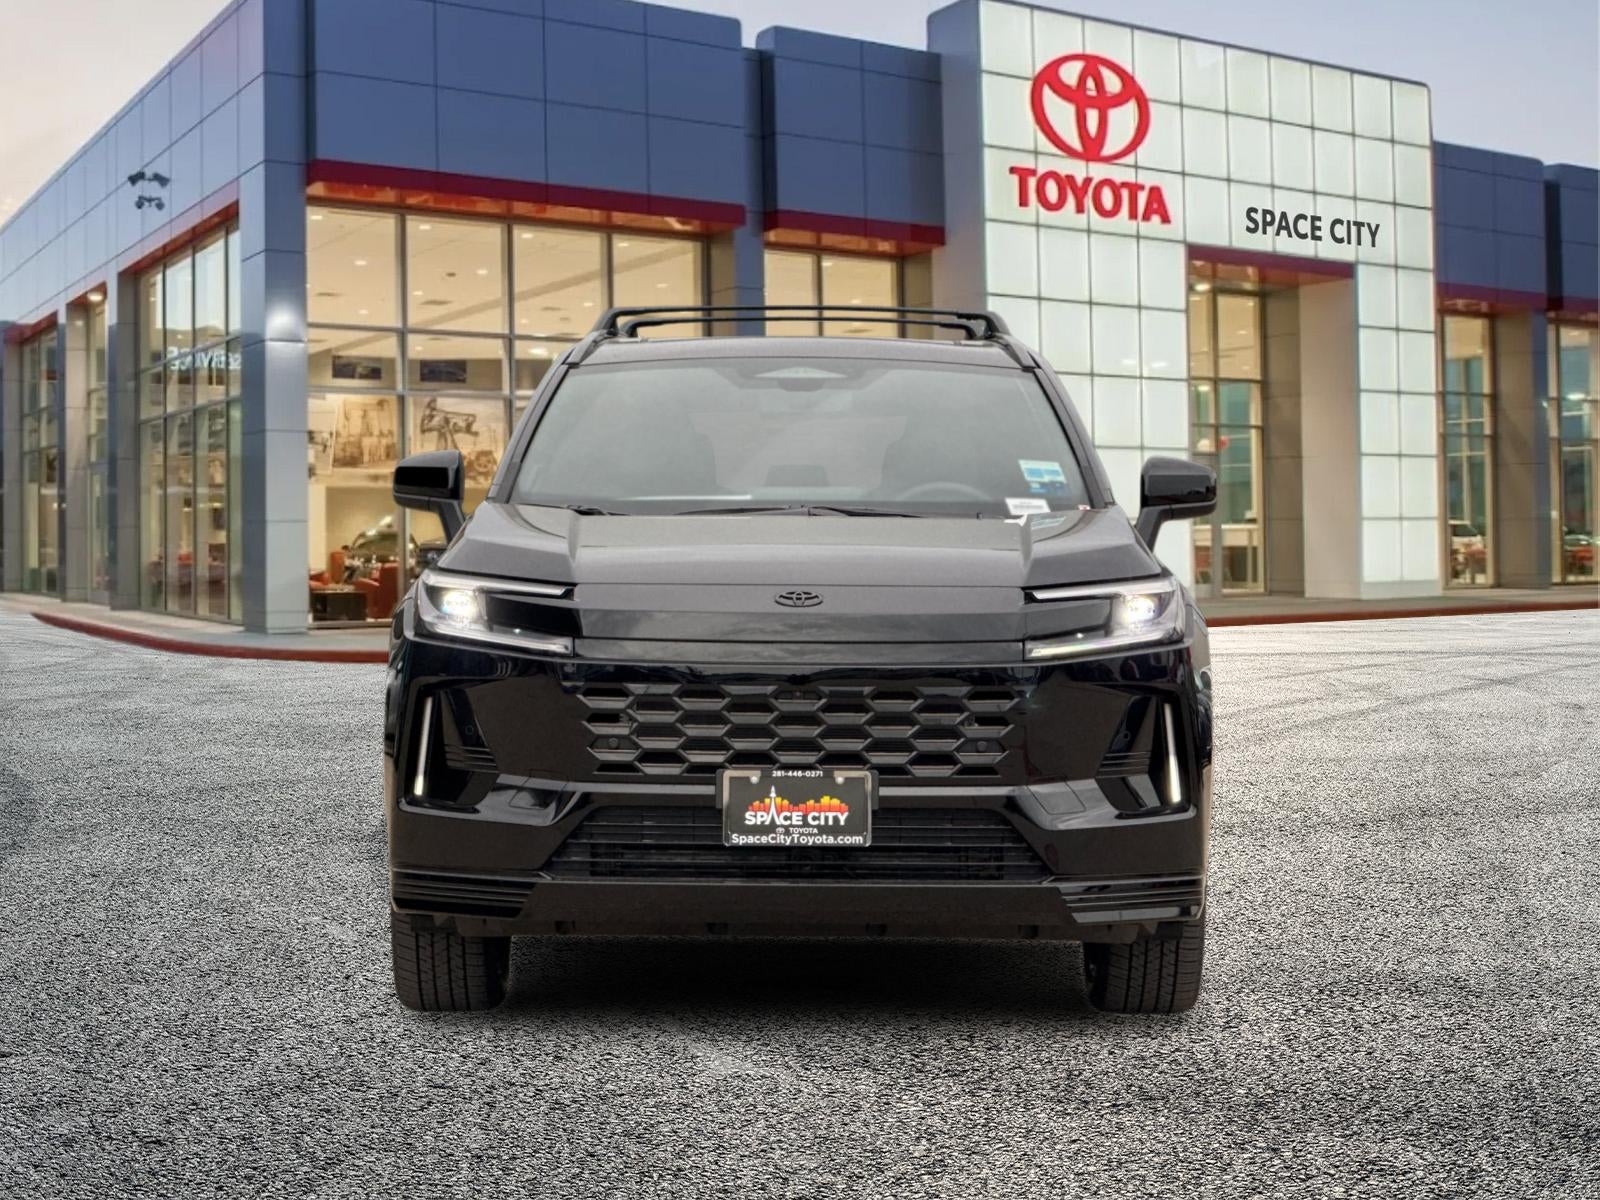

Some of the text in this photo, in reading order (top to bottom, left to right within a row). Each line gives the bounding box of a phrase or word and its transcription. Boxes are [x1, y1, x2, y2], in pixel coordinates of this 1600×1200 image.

[1009, 166, 1171, 224] TOYOTA
[1245, 206, 1381, 248] SPACE CITY
[771, 770, 824, 778] 281-446-0271
[807, 811, 849, 826] CITY
[731, 833, 863, 845] SpaceCityToyota.com
